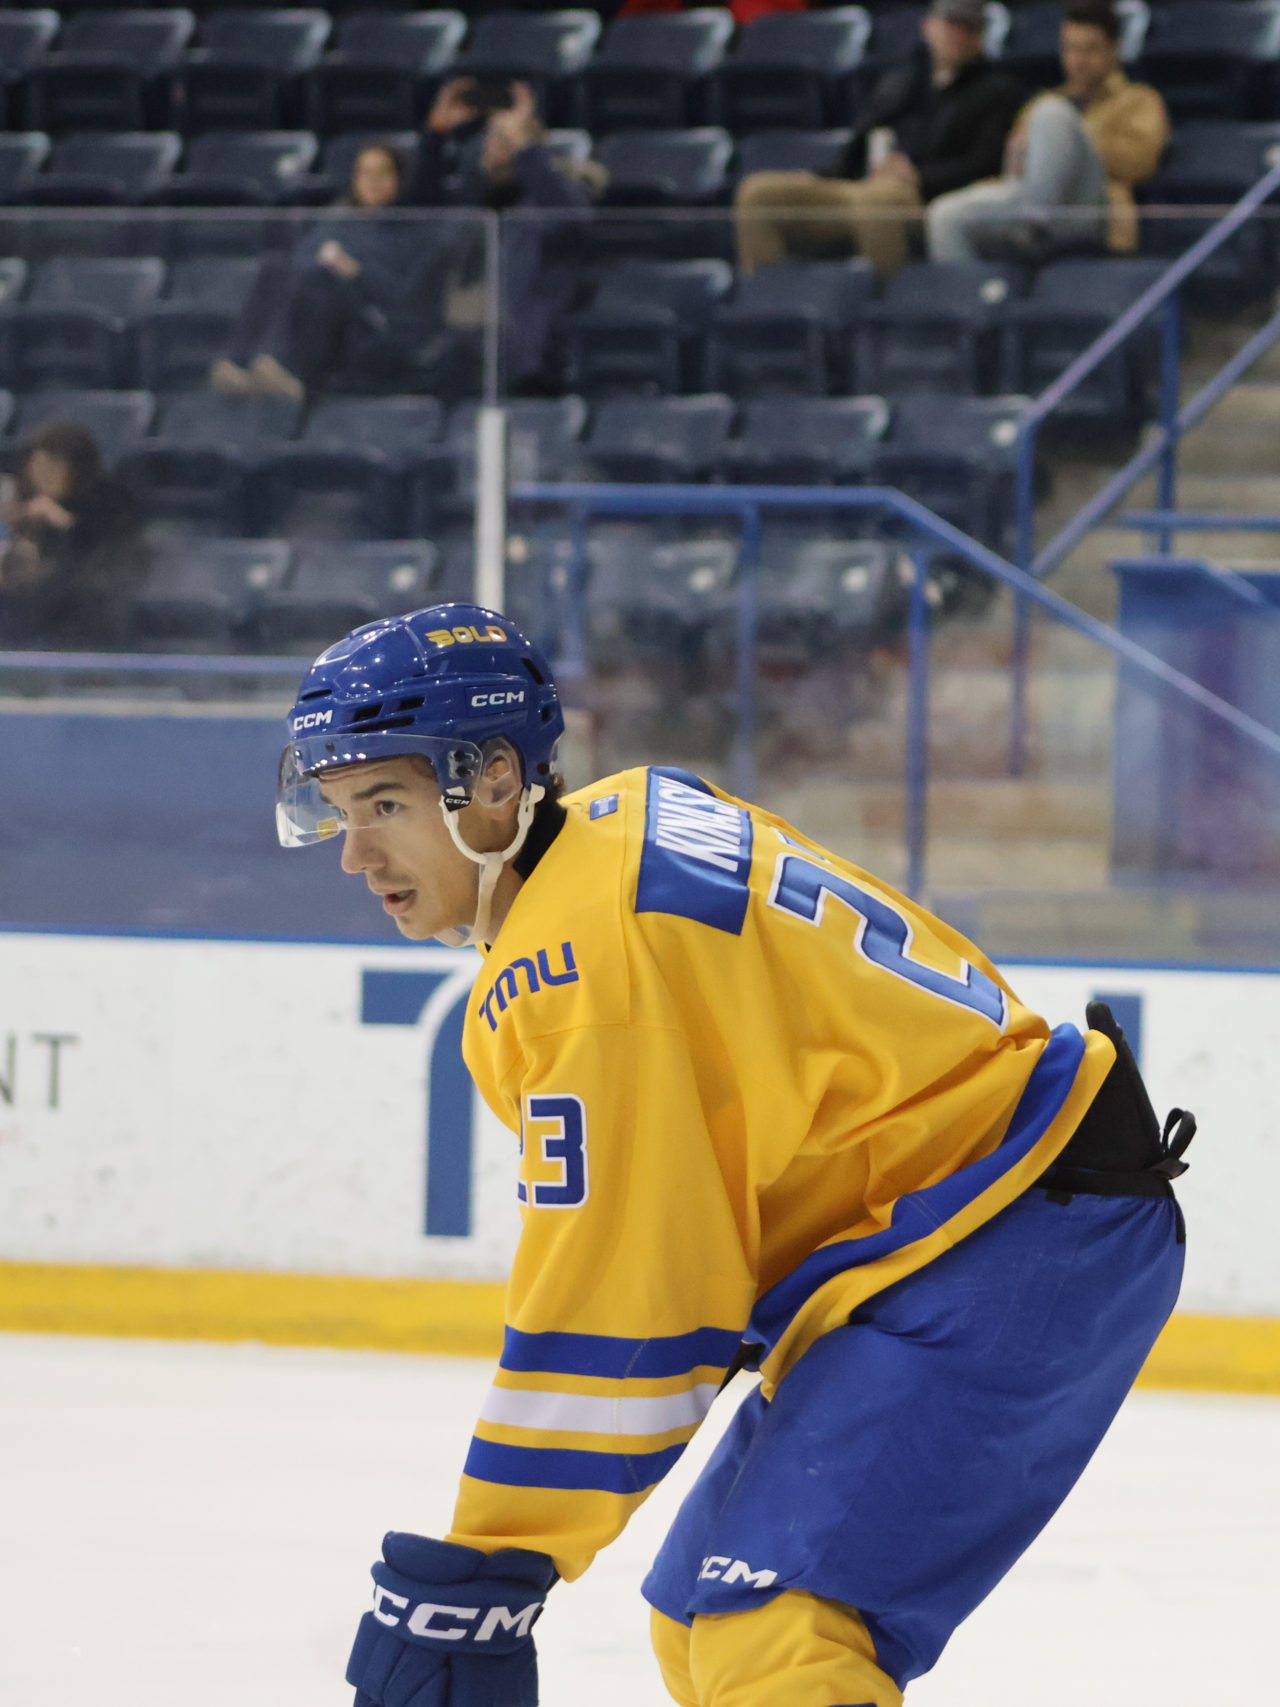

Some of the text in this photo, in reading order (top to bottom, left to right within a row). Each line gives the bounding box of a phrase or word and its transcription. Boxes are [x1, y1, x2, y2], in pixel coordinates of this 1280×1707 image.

[425, 625, 508, 646] BOLD
[293, 709, 333, 731] CCM
[471, 691, 525, 707] CCM
[766, 827, 1010, 1035] 2
[478, 941, 580, 1033] TMU
[518, 1093, 590, 1208] 3
[697, 1555, 778, 1589] CM
[374, 1584, 541, 1642] CCM
